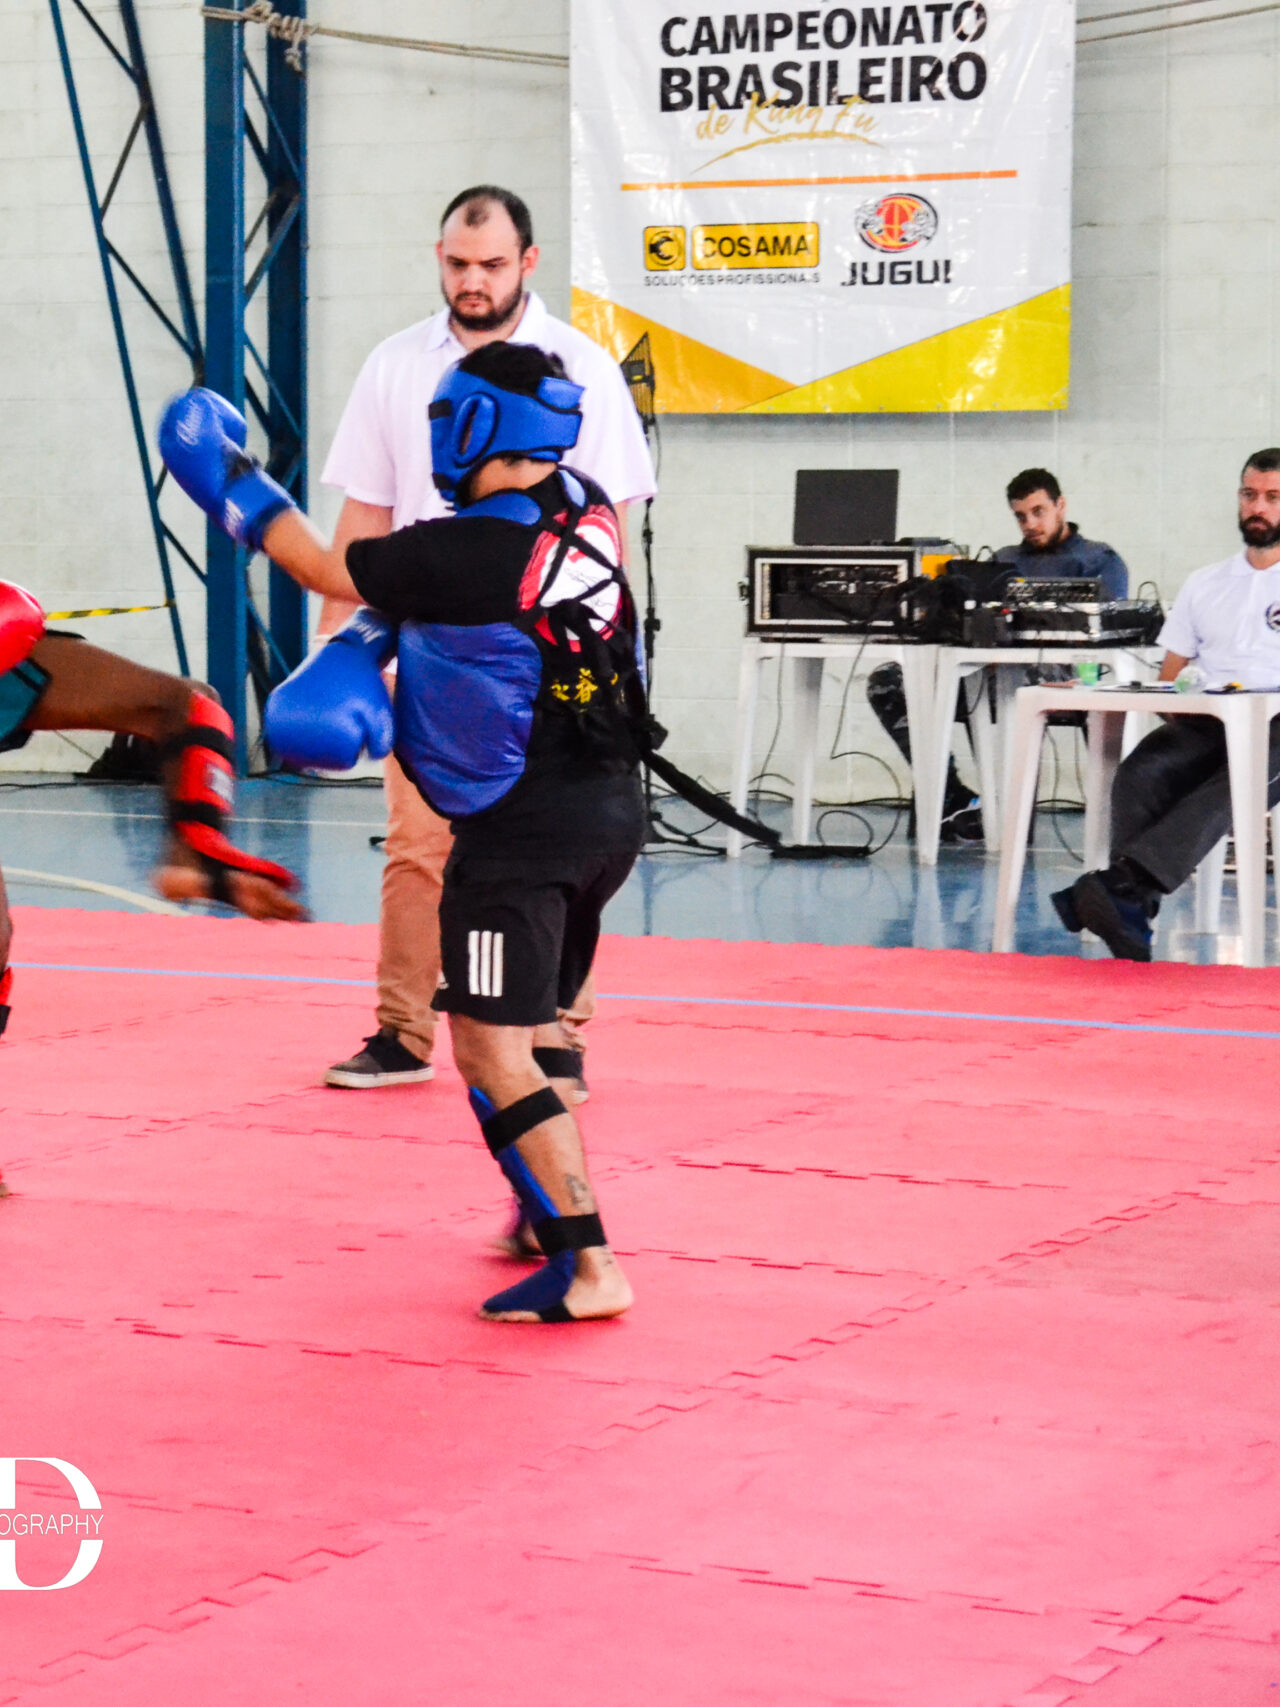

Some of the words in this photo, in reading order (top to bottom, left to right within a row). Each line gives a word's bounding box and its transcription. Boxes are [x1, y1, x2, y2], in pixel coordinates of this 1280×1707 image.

[660, 0, 987, 57] CAMPEONATO
[660, 51, 987, 112] BRASILEIRO
[696, 103, 734, 139] de
[743, 89, 825, 134] Kung
[832, 94, 879, 133] Fu
[703, 234, 812, 259] COSAMA
[717, 271, 820, 285] PROFISSIONAS
